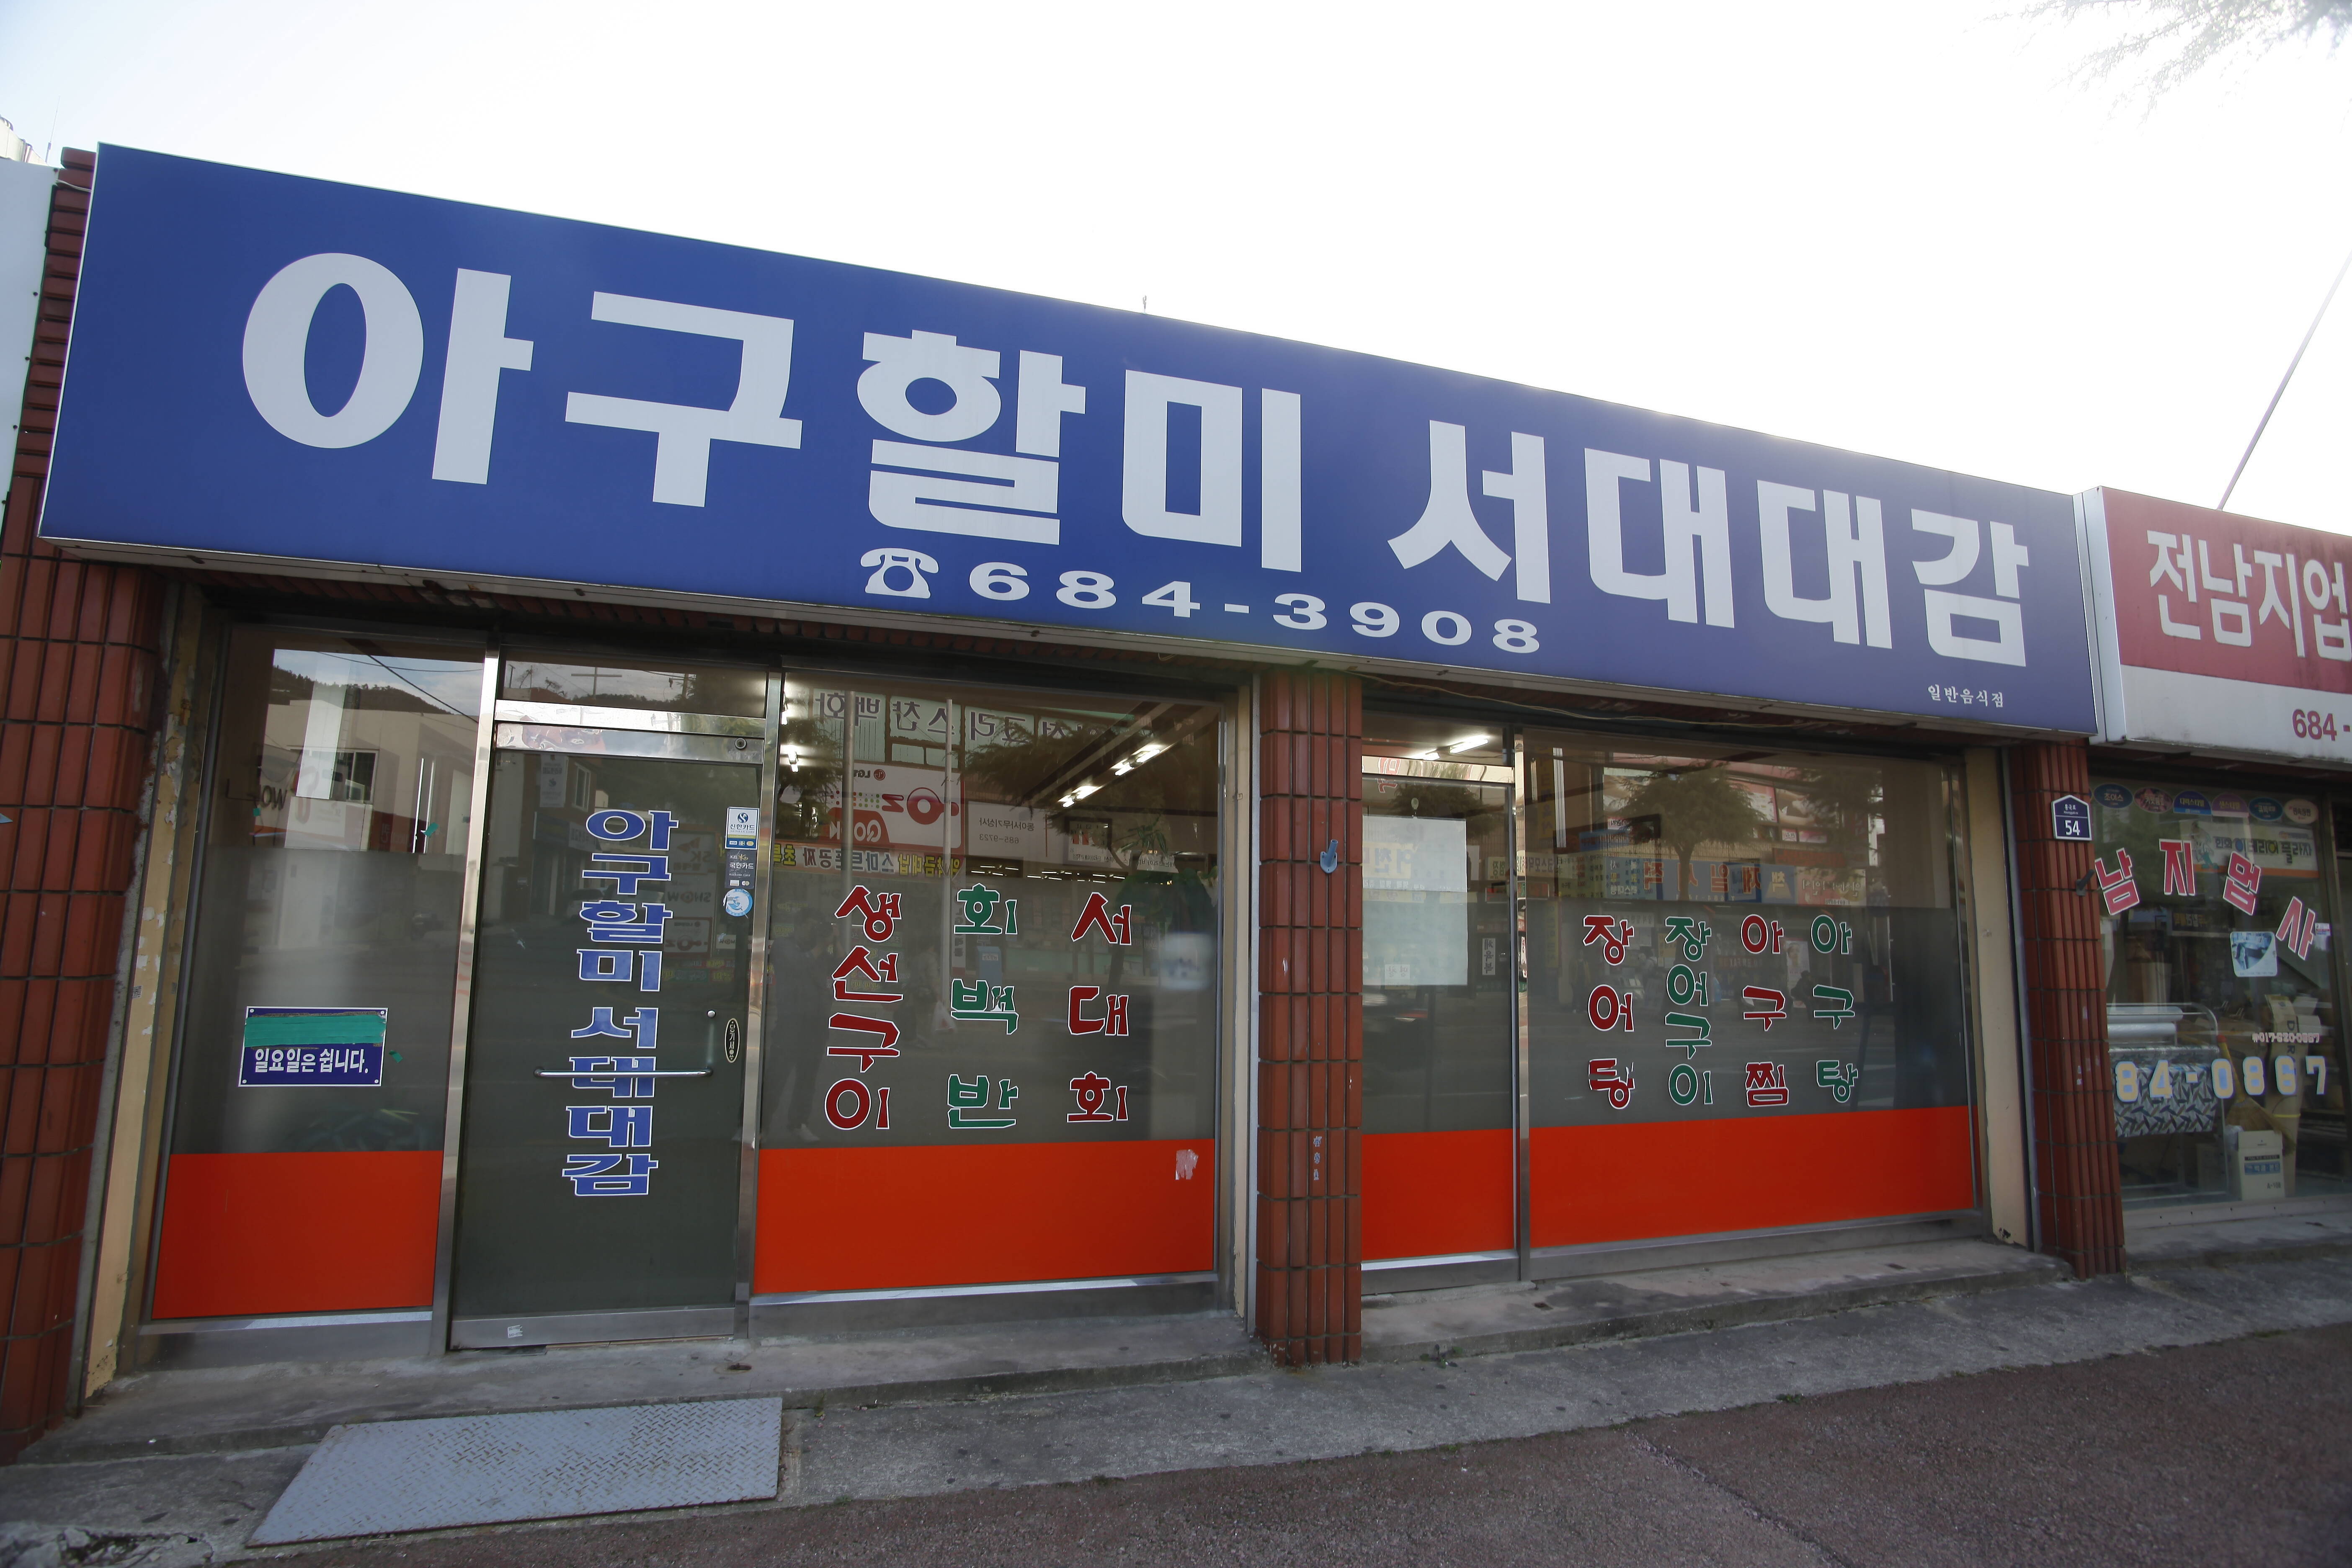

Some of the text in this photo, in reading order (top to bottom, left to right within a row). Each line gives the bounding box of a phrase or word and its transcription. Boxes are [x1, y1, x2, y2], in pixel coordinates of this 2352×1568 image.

[969, 561, 1540, 654] 684-3908
[1927, 684, 2004, 709] 일반음식점
[2065, 820, 2080, 836] 54
[255, 1048, 369, 1073] 일요일은 쉽니다.
[824, 885, 904, 1130] 생선구이
[947, 882, 1019, 1129] 회백반
[1066, 891, 1132, 1123] 서대회
[1582, 914, 1635, 1110] 장어탕
[1664, 916, 1712, 1106] 장어구이
[1740, 914, 1790, 1108] 아구찜
[1810, 914, 1859, 1104] 아구탕
[2115, 1055, 2327, 1103] 84-0867
